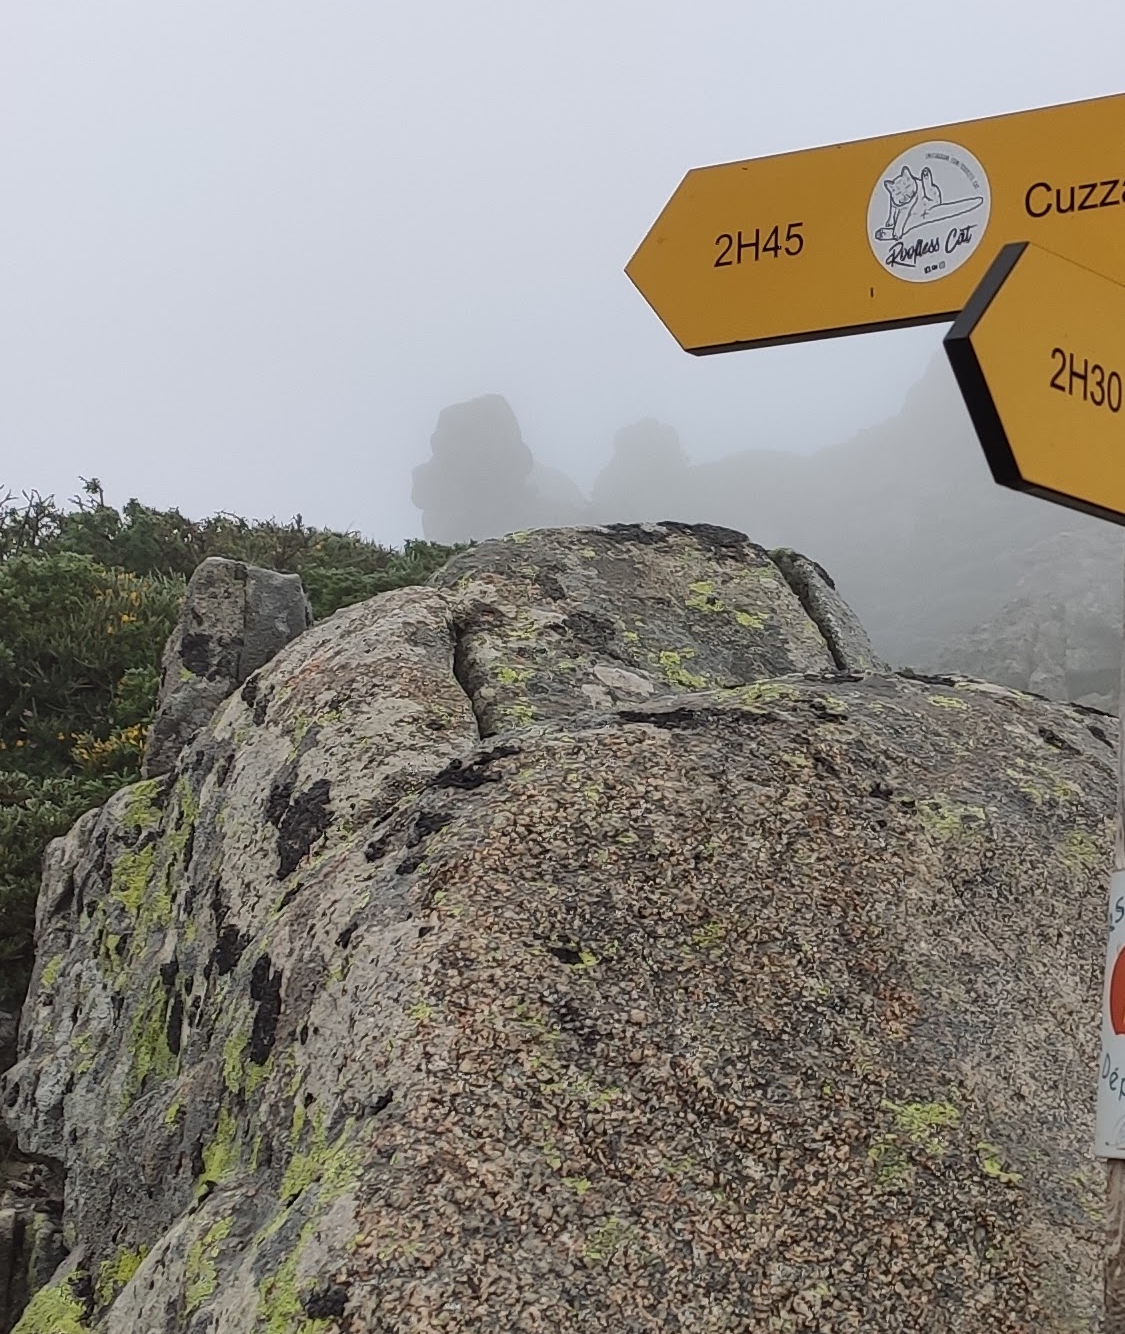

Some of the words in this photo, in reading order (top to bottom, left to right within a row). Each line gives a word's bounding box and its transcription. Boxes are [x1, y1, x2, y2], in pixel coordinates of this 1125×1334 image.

[713, 221, 805, 268] 2H45
[885, 237, 940, 267] Roofless
[945, 224, 978, 253] Cat
[1049, 347, 1123, 414] 2H30
